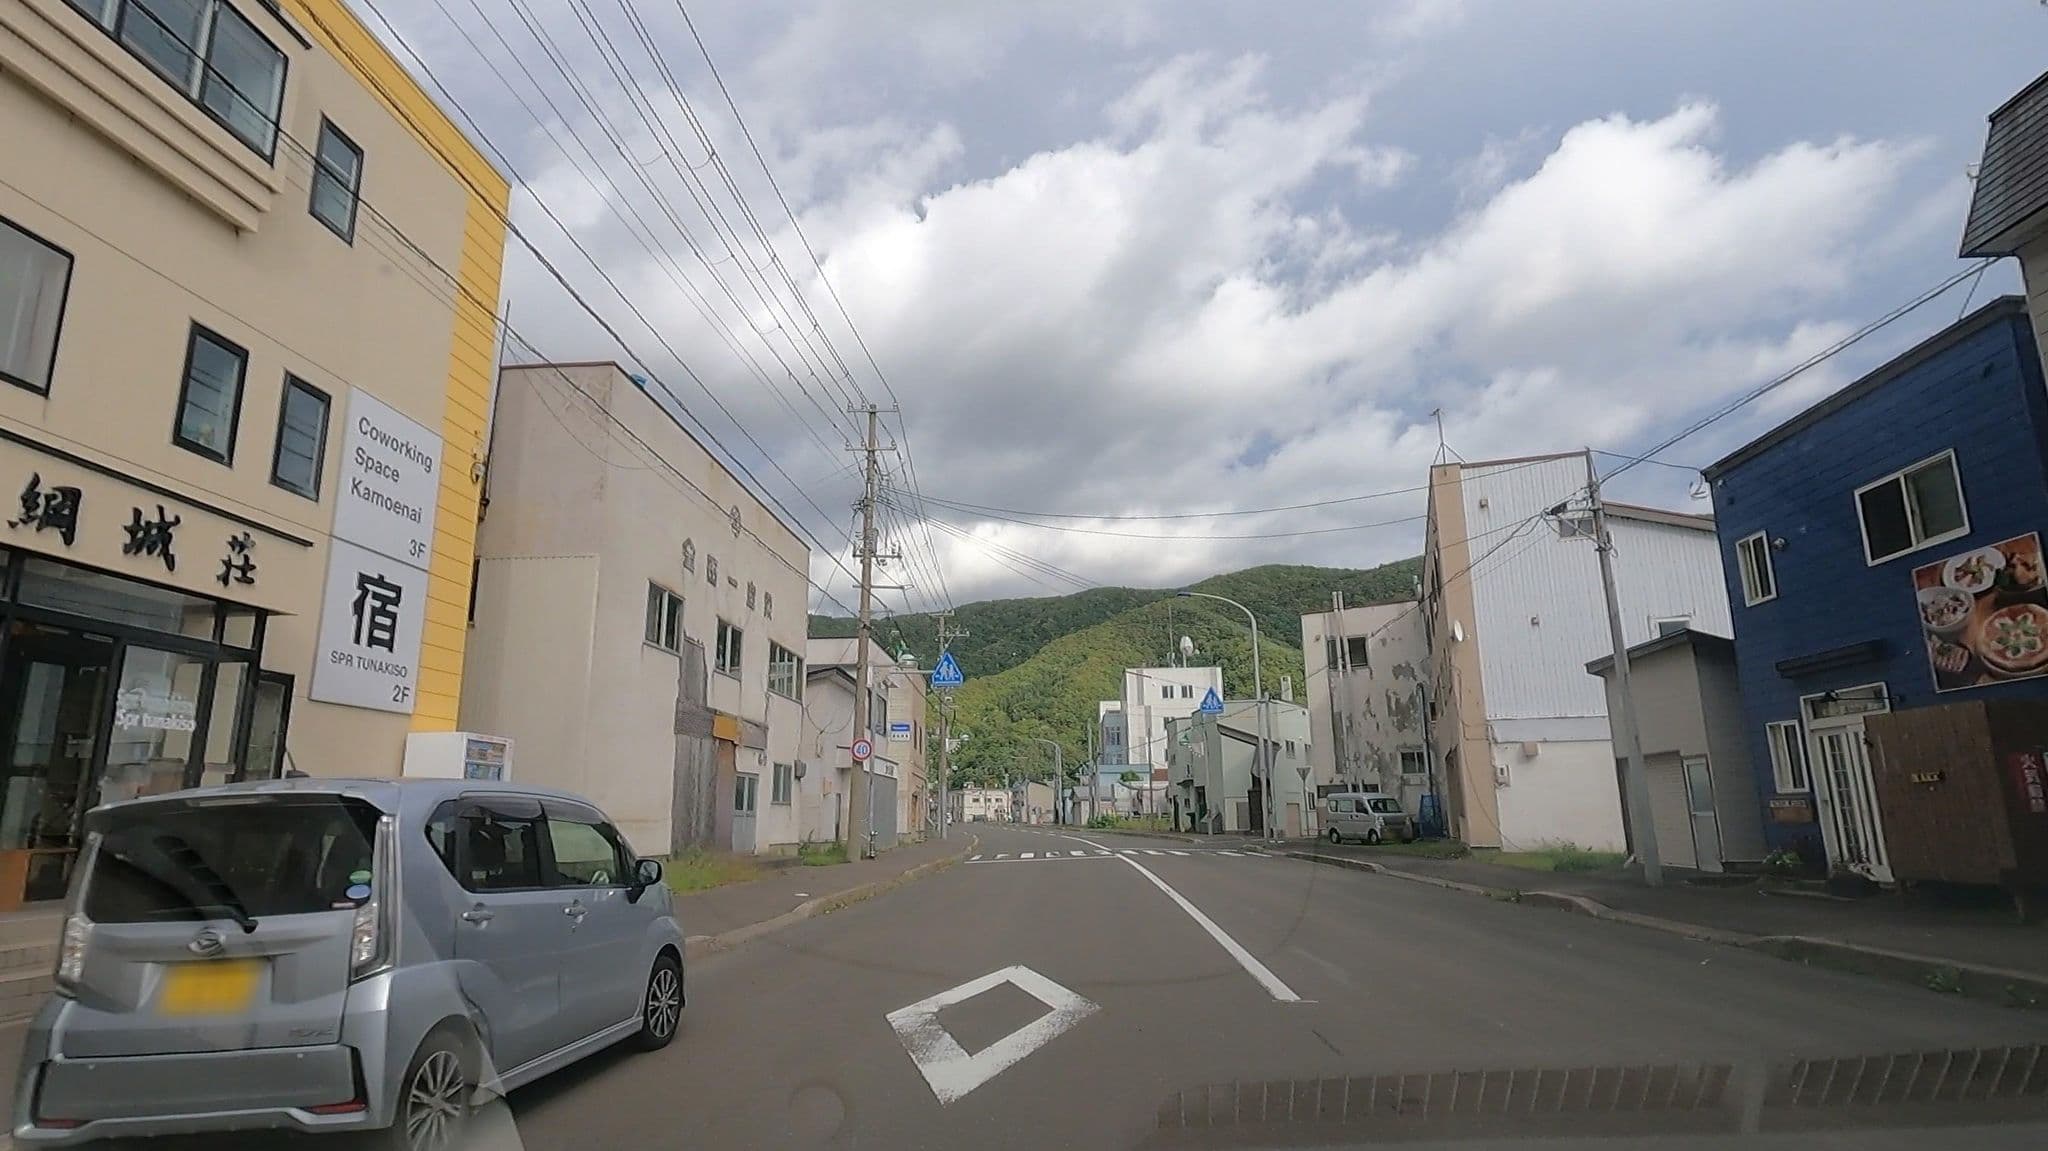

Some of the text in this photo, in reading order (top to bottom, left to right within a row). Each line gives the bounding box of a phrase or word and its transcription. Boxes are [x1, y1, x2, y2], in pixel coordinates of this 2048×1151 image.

[358, 416, 433, 474] Coworking
[354, 446, 400, 483] Space
[350, 477, 423, 524] Kamoenai
[408, 539, 427, 559] 3F
[353, 571, 402, 653] 宿
[330, 650, 408, 678] SPR TUNAKISO
[392, 685, 411, 703] 2F
[856, 744, 869, 755] 40
